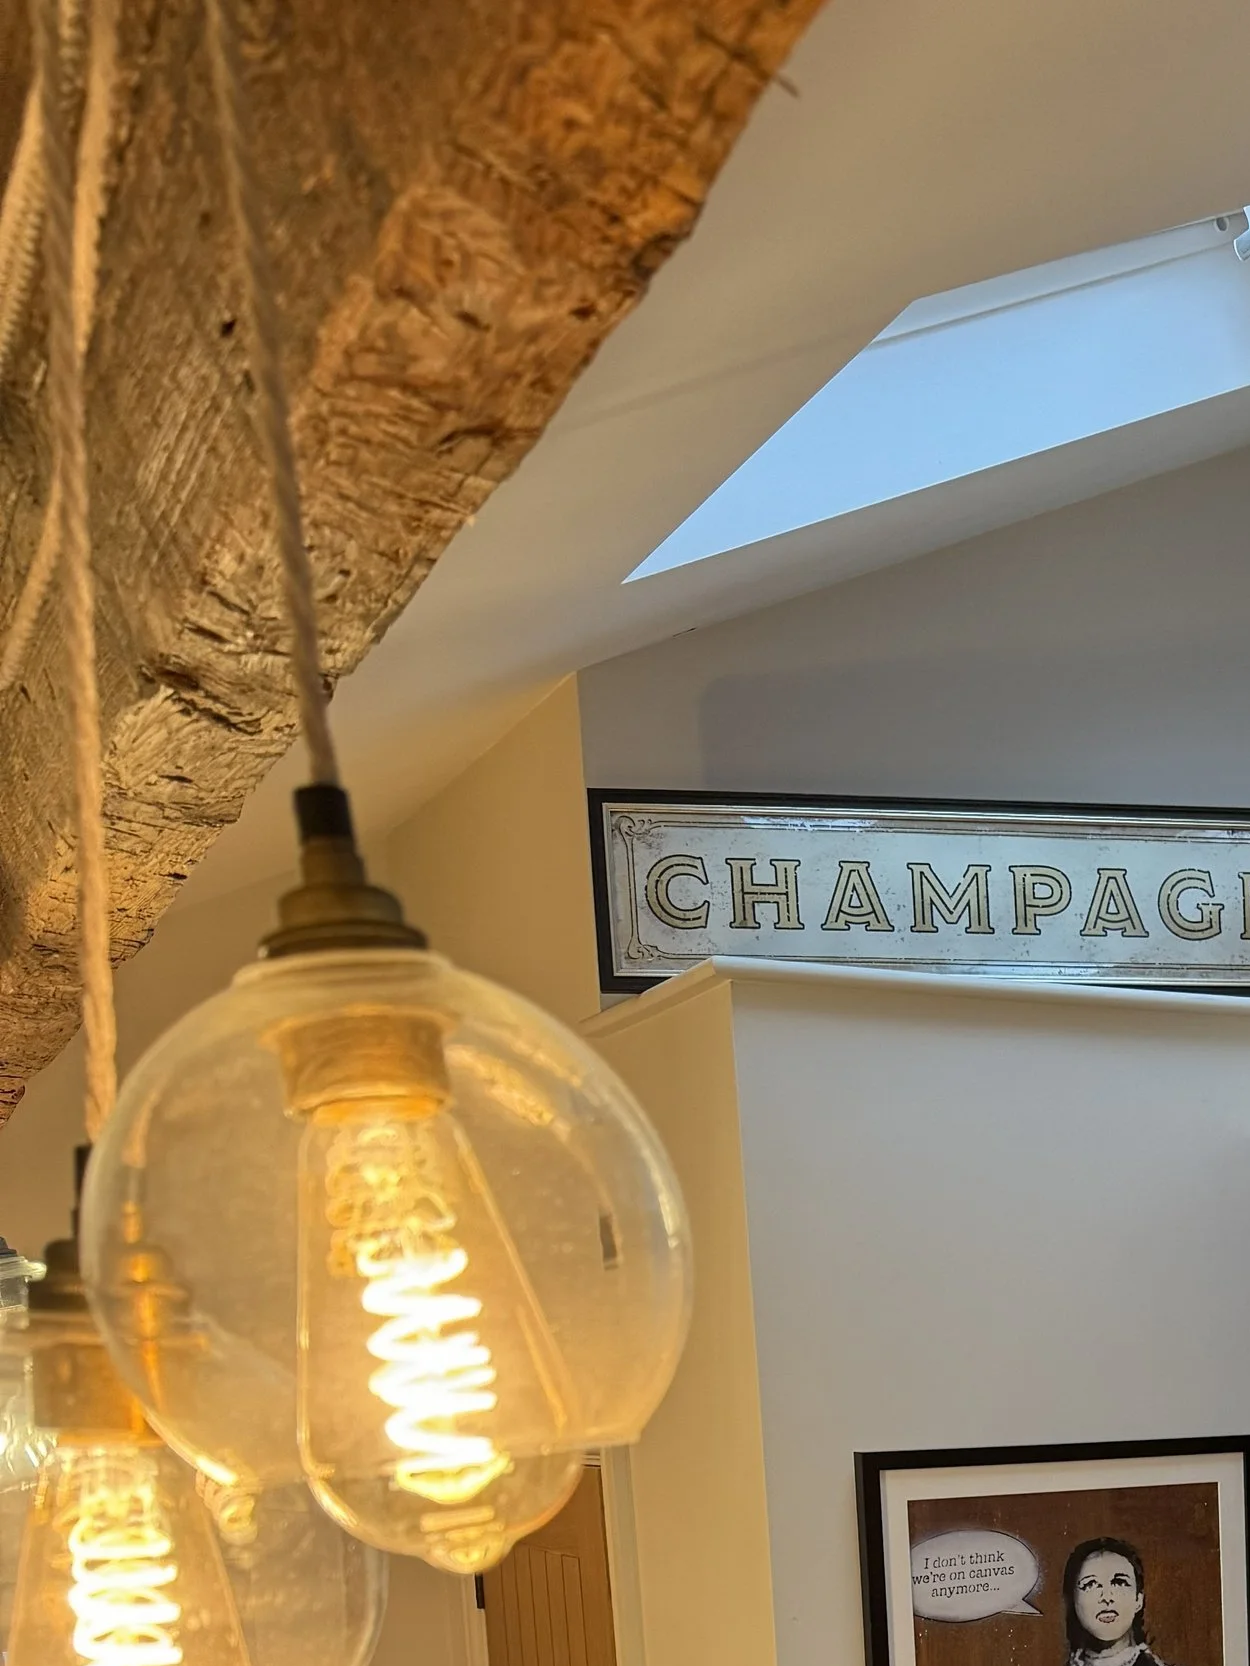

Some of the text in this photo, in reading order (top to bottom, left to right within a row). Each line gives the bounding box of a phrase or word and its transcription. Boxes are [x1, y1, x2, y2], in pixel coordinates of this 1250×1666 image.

[924, 1550, 1005, 1569] I don't think
[912, 1565, 1015, 1585] we're on canvas
[931, 1582, 1000, 1598] anymore...
